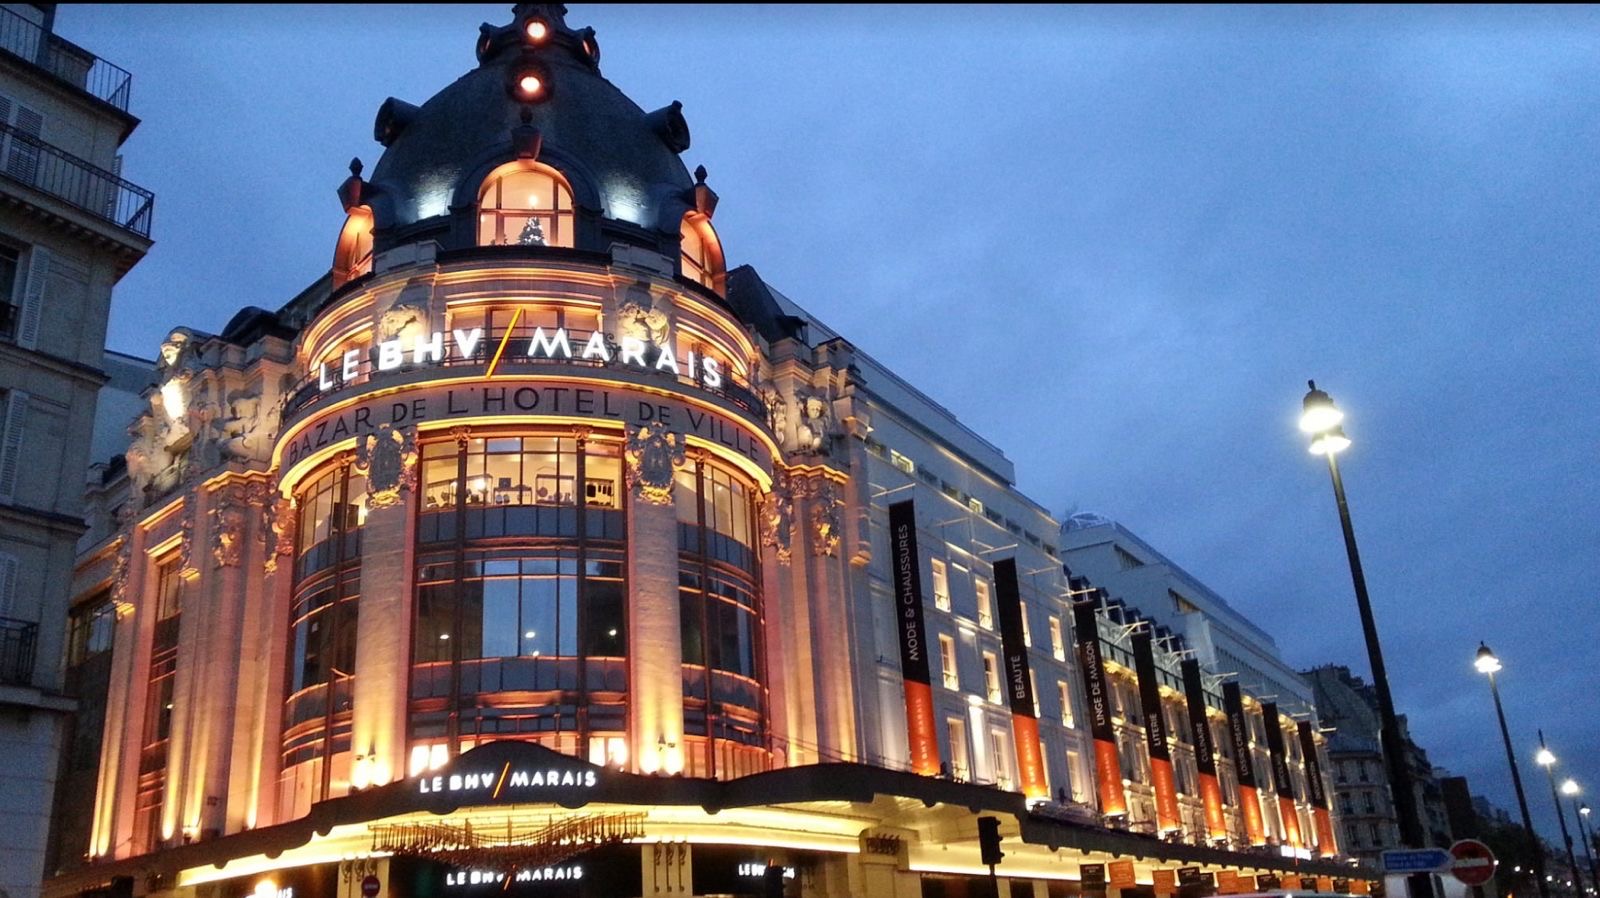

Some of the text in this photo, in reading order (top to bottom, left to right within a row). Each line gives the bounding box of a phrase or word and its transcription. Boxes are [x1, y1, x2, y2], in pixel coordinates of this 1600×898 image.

[319, 348, 358, 391] LE
[378, 328, 482, 370] BHV
[527, 327, 722, 388] MARAIS
[289, 406, 374, 466] BAZAR
[391, 399, 426, 424] DE
[638, 402, 671, 426] DE
[685, 407, 760, 461] VILLE
[898, 524, 914, 605] CHAUSSURES
[908, 620, 920, 661] MODE
[1091, 681, 1101, 695] DE
[1093, 696, 1105, 727] LINGE
[419, 776, 443, 794] LE
[449, 773, 494, 791] BHV
[509, 770, 597, 788] MARAIS
[446, 872, 466, 886] LE
[516, 866, 583, 882] MARAIS
